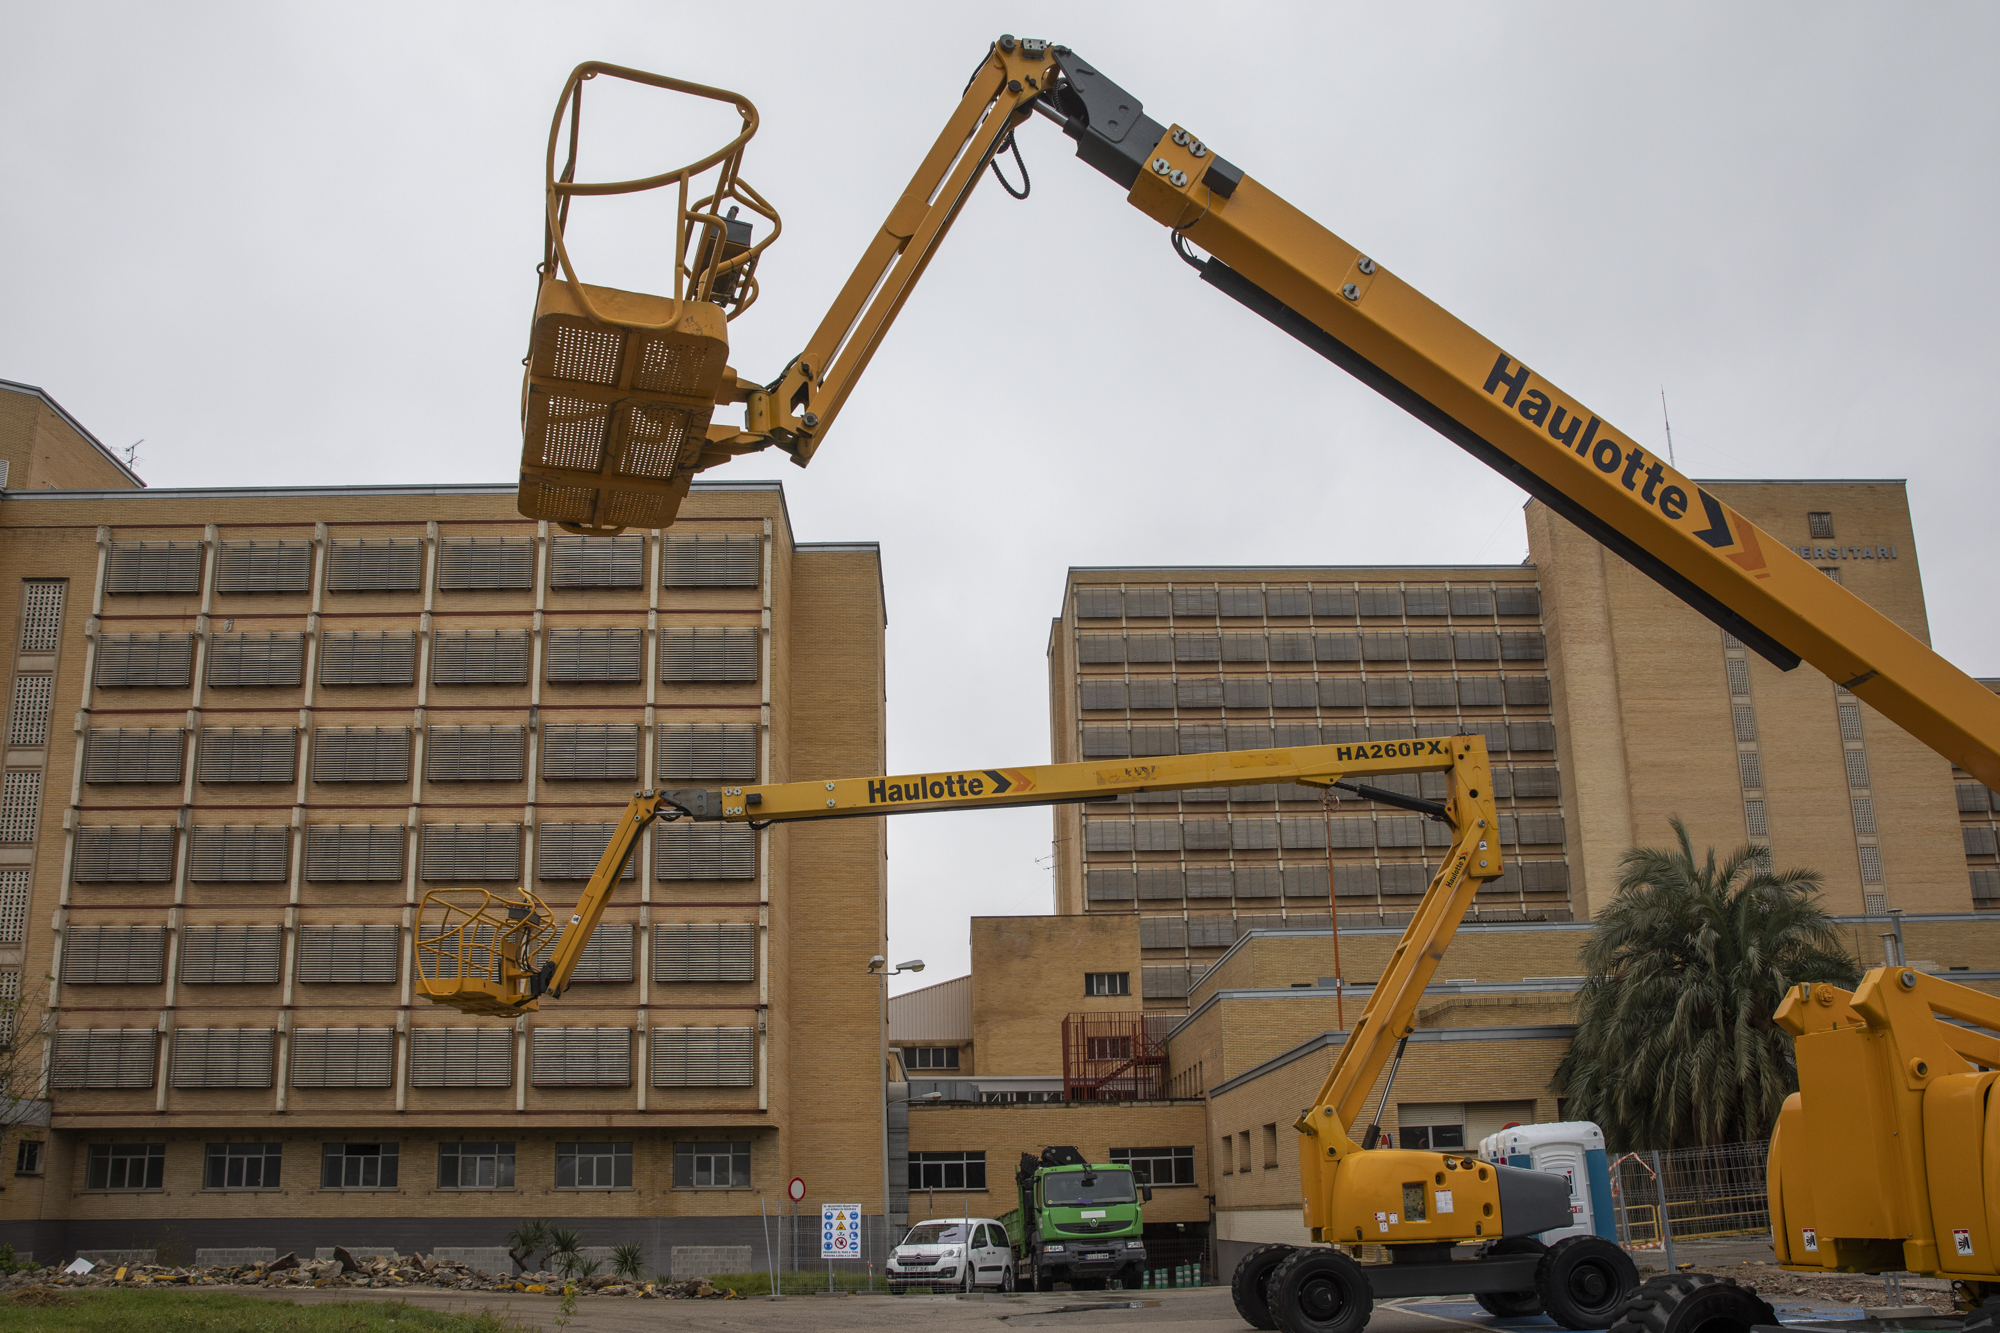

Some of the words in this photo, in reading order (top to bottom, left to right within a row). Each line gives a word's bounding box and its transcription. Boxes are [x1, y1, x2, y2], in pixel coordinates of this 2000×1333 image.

[1483, 352, 1688, 520] Haulotte
[1336, 741, 1443, 761] HA260PX
[868, 774, 984, 803] Haulotte
[1445, 861, 1464, 888] Haulotte
